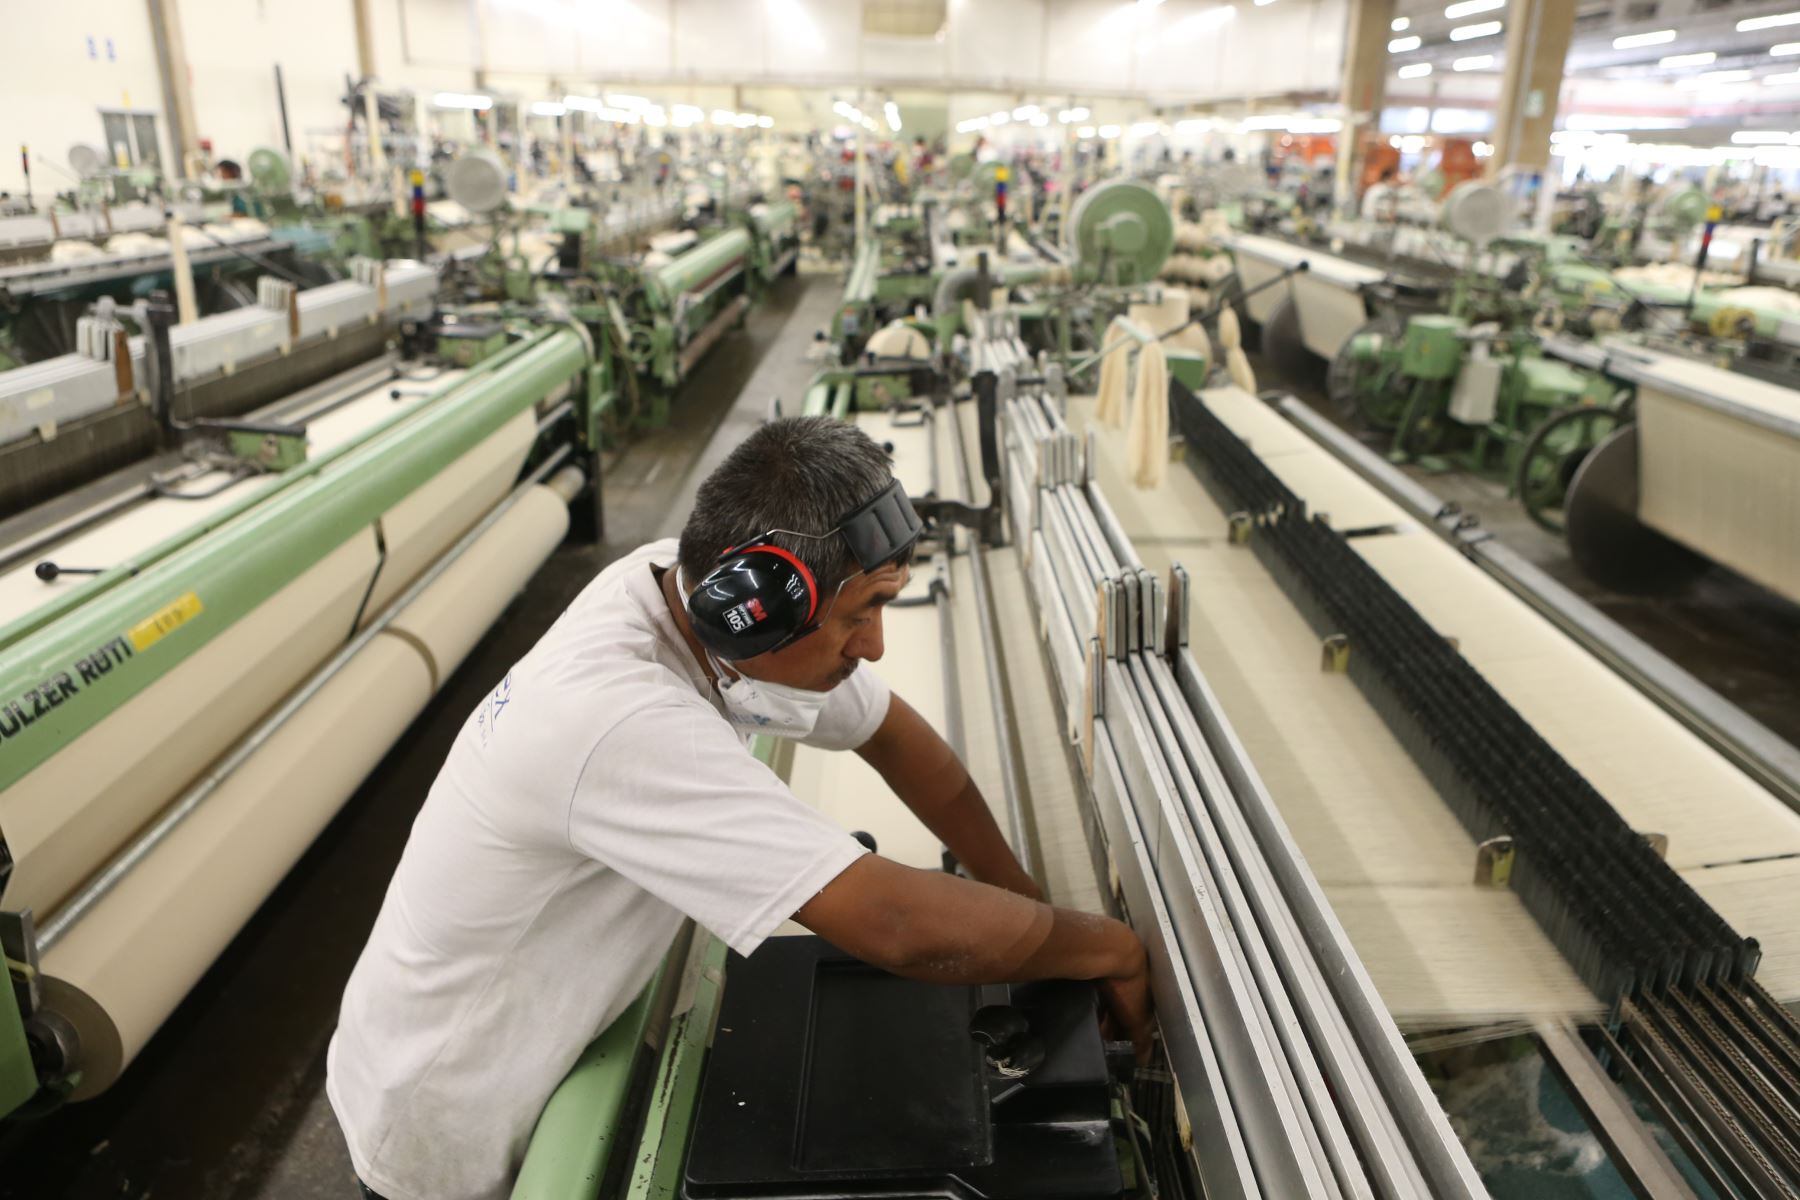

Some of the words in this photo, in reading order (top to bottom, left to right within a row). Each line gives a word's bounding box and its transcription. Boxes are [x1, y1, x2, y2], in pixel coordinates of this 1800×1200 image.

[727, 609, 745, 631] 105
[746, 598, 768, 621] 3M
[0, 672, 79, 744] ULZER
